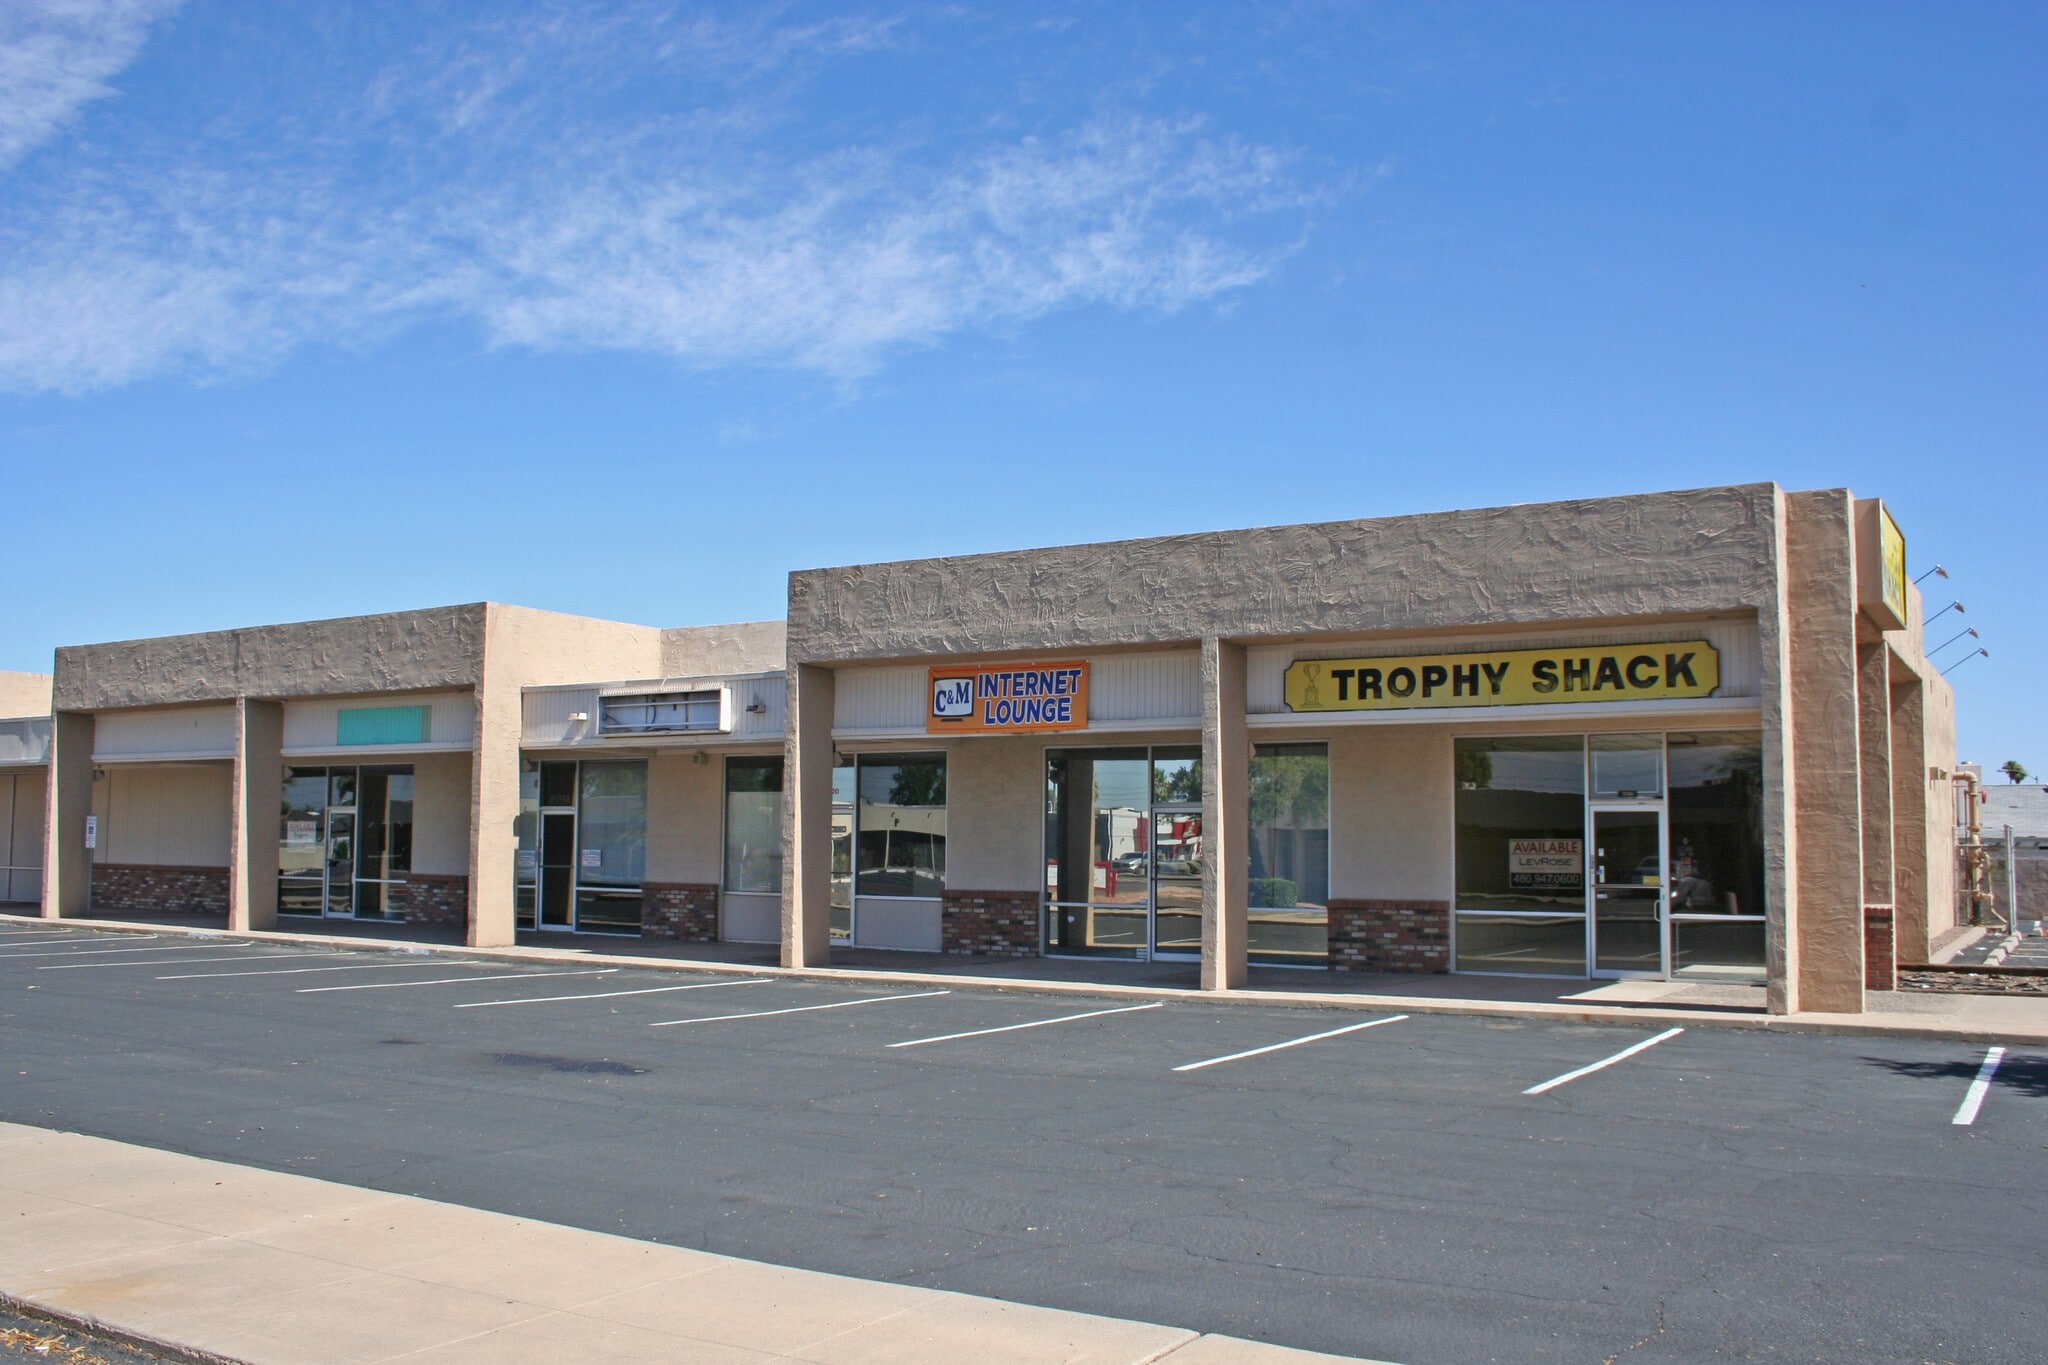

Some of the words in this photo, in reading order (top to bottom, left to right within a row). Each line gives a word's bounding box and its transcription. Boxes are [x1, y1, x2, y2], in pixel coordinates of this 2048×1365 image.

[978, 668, 1082, 699] INTERNET
[1331, 662, 1510, 702] TROPHY
[1532, 652, 1698, 694] SHACK
[935, 681, 971, 714] C&M
[984, 696, 1073, 726] LOUNGE
[1513, 841, 1578, 854] AVAILABLE
